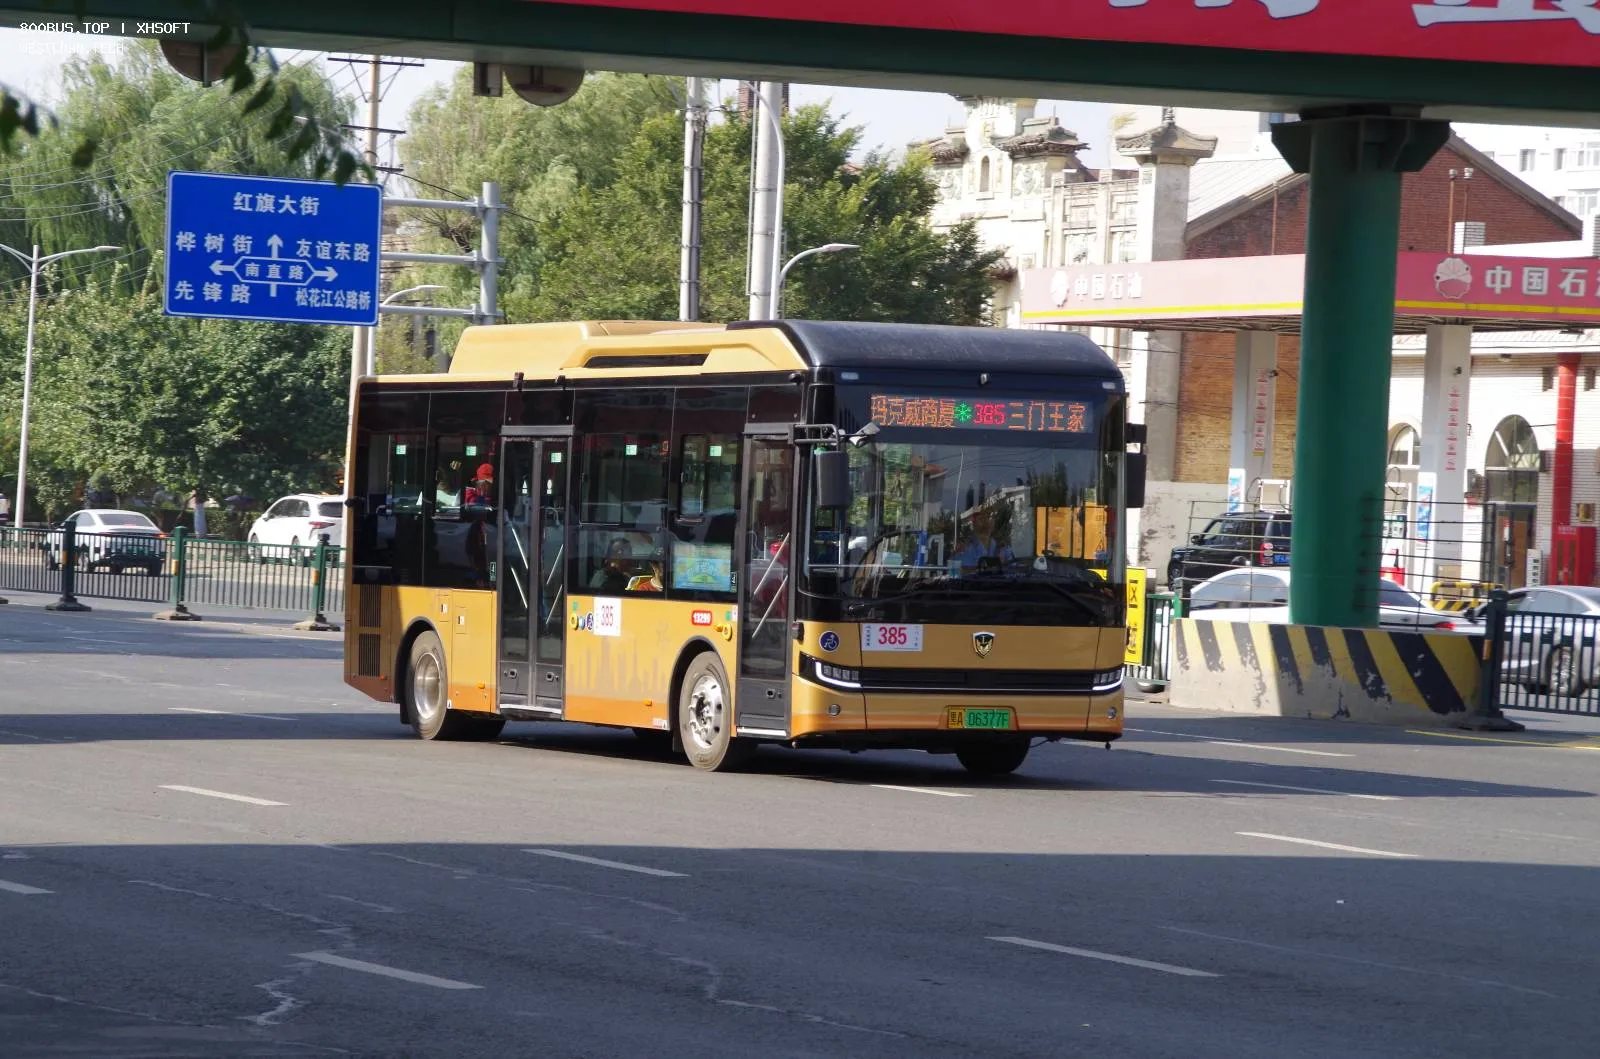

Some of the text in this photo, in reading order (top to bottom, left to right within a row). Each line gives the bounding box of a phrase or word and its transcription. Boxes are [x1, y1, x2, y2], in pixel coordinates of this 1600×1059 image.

[233, 192, 320, 216] 红旗大街
[176, 231, 253, 255] 桦树街
[296, 239, 371, 262] 友谊东路
[245, 263, 304, 280] 南直路
[1485, 265, 1600, 297] 中国石
[174, 281, 251, 304] 先锋路
[295, 288, 371, 310] 松花江公路桥
[973, 403, 1005, 425] 385
[600, 605, 614, 627] 385
[879, 626, 908, 645] 385
